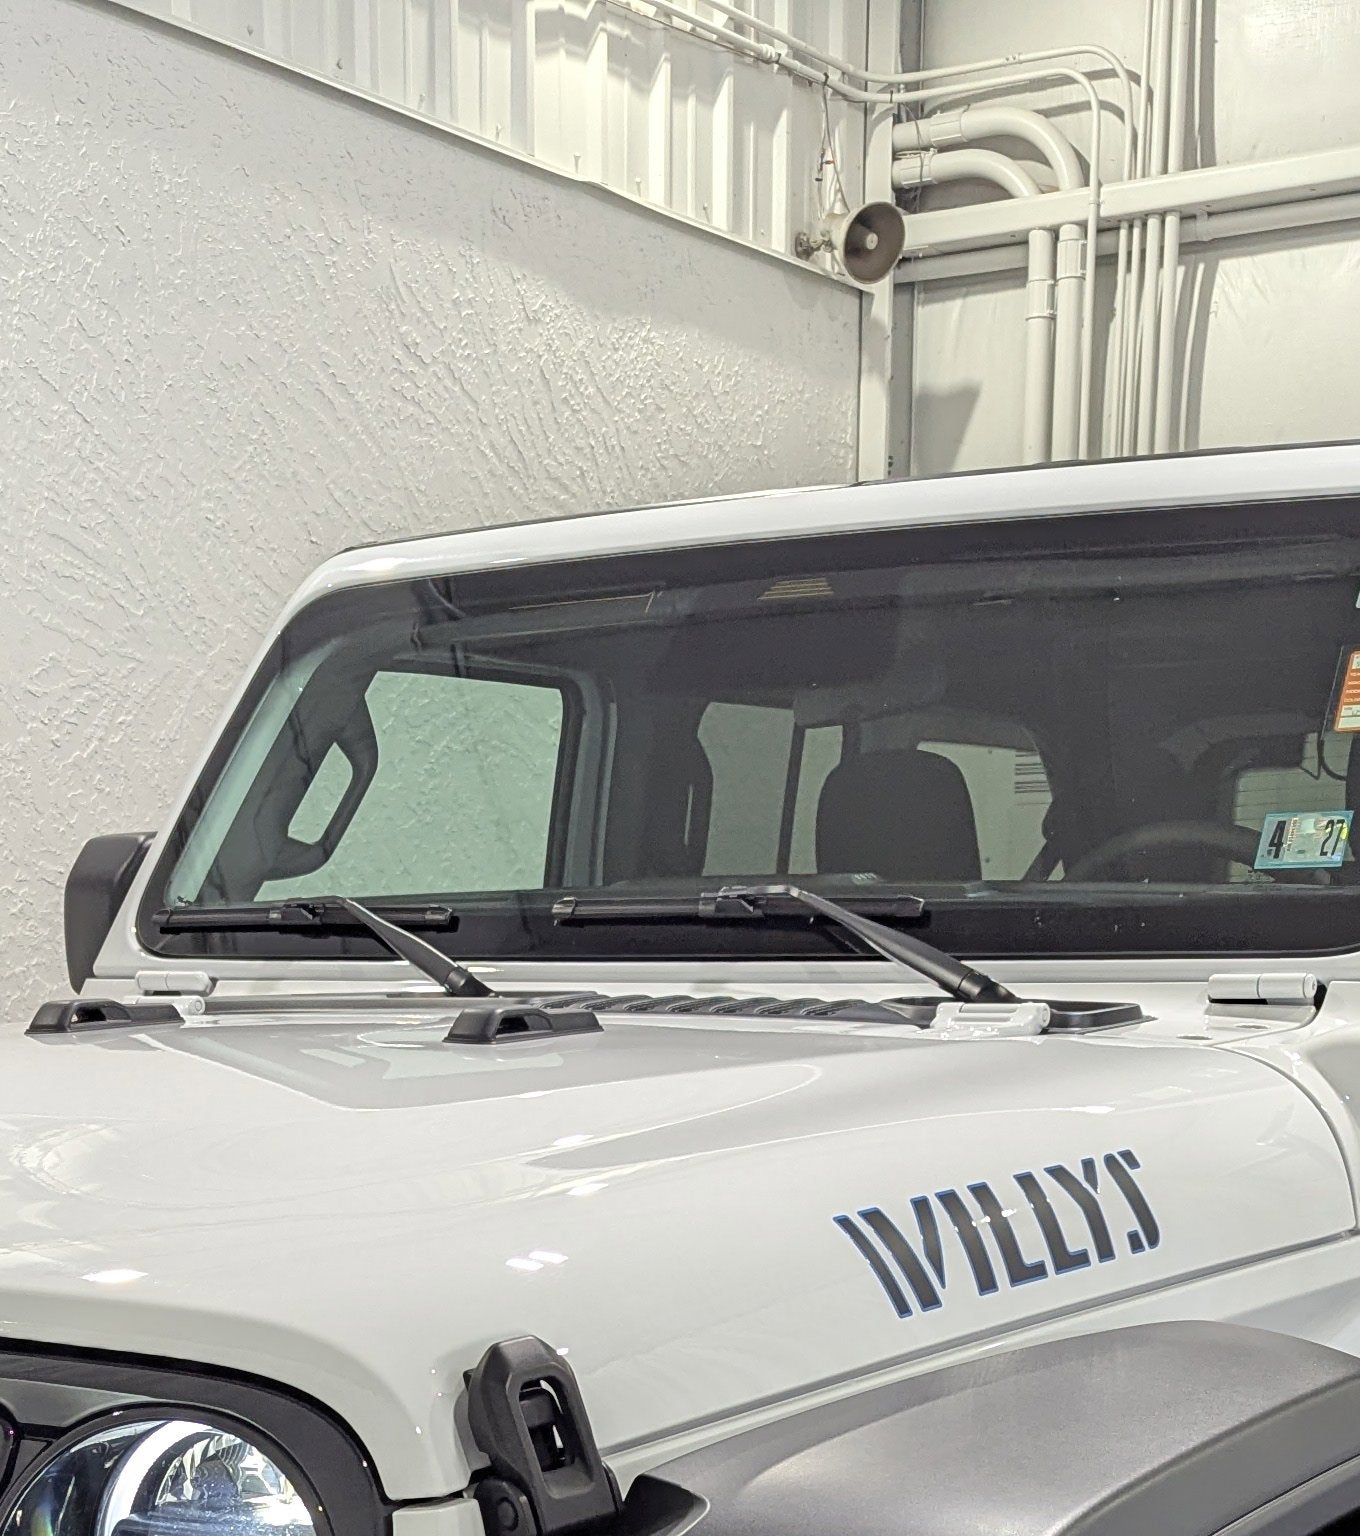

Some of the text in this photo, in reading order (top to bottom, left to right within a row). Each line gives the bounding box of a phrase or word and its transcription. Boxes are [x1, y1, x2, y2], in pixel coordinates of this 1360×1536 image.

[1269, 820, 1287, 859] 4
[1320, 819, 1346, 857] 27
[833, 1150, 1160, 1319] WILLYS
